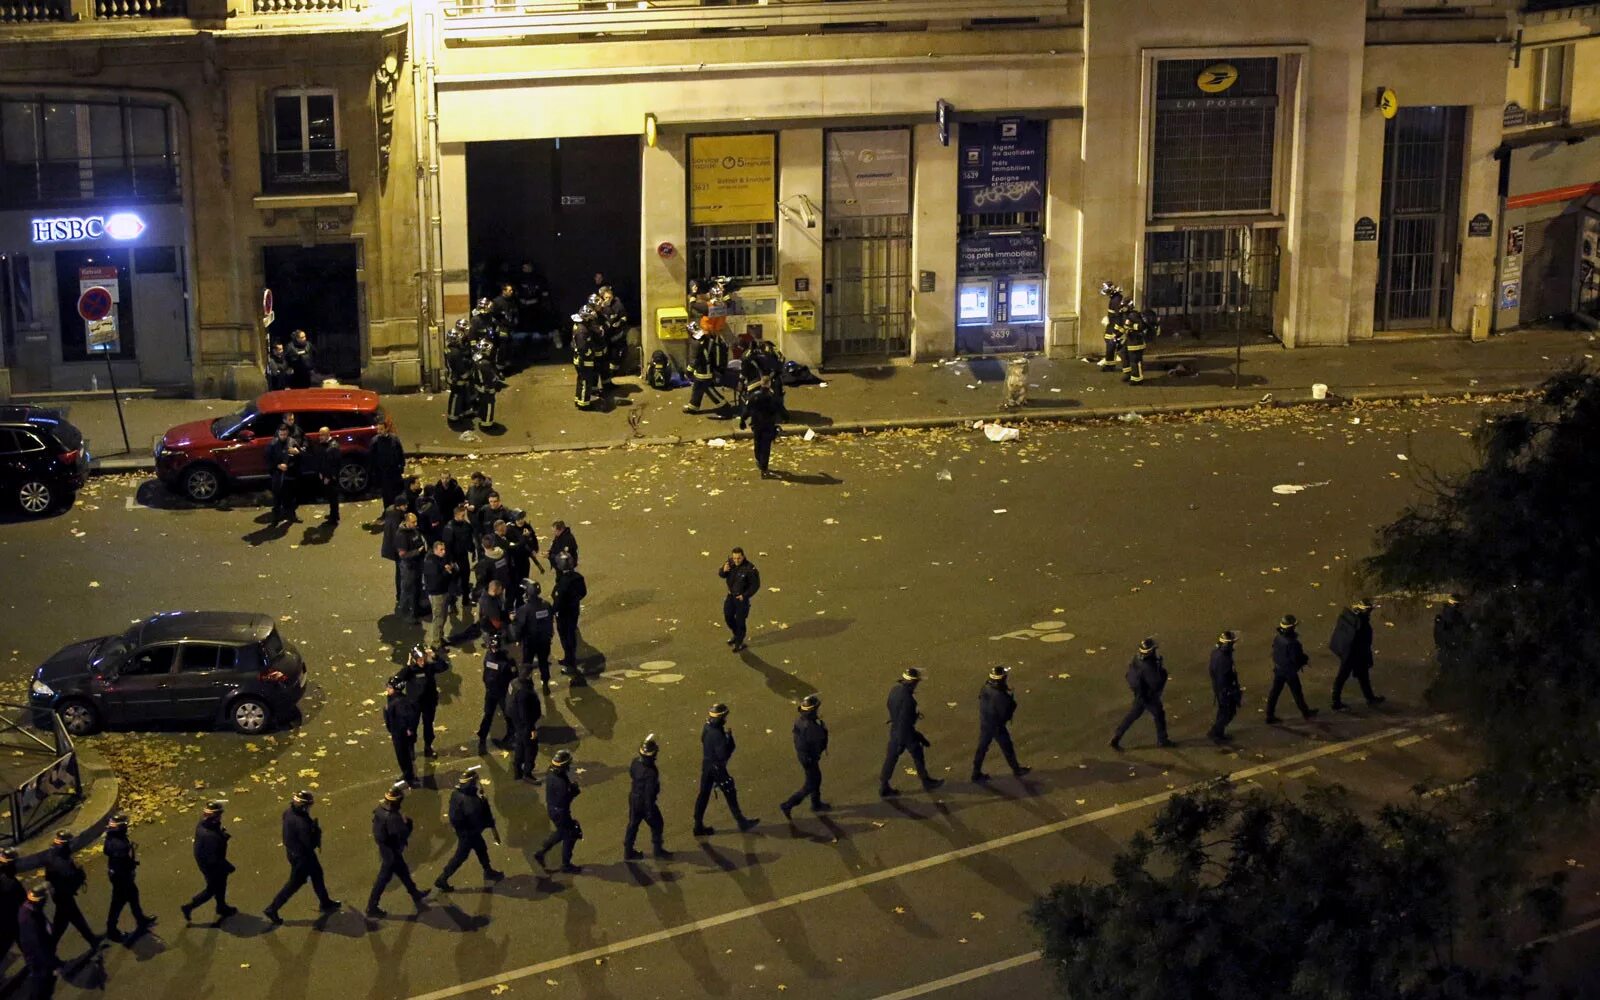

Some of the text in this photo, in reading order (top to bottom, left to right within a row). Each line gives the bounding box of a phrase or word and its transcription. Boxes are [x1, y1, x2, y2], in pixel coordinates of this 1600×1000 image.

[1176, 98, 1258, 109] LA POSTE
[1003, 149, 1035, 157] quotidien
[737, 156, 746, 168] 5
[32, 217, 105, 243] HSBC
[977, 251, 994, 260] prêts
[990, 329, 1010, 339] 3639
